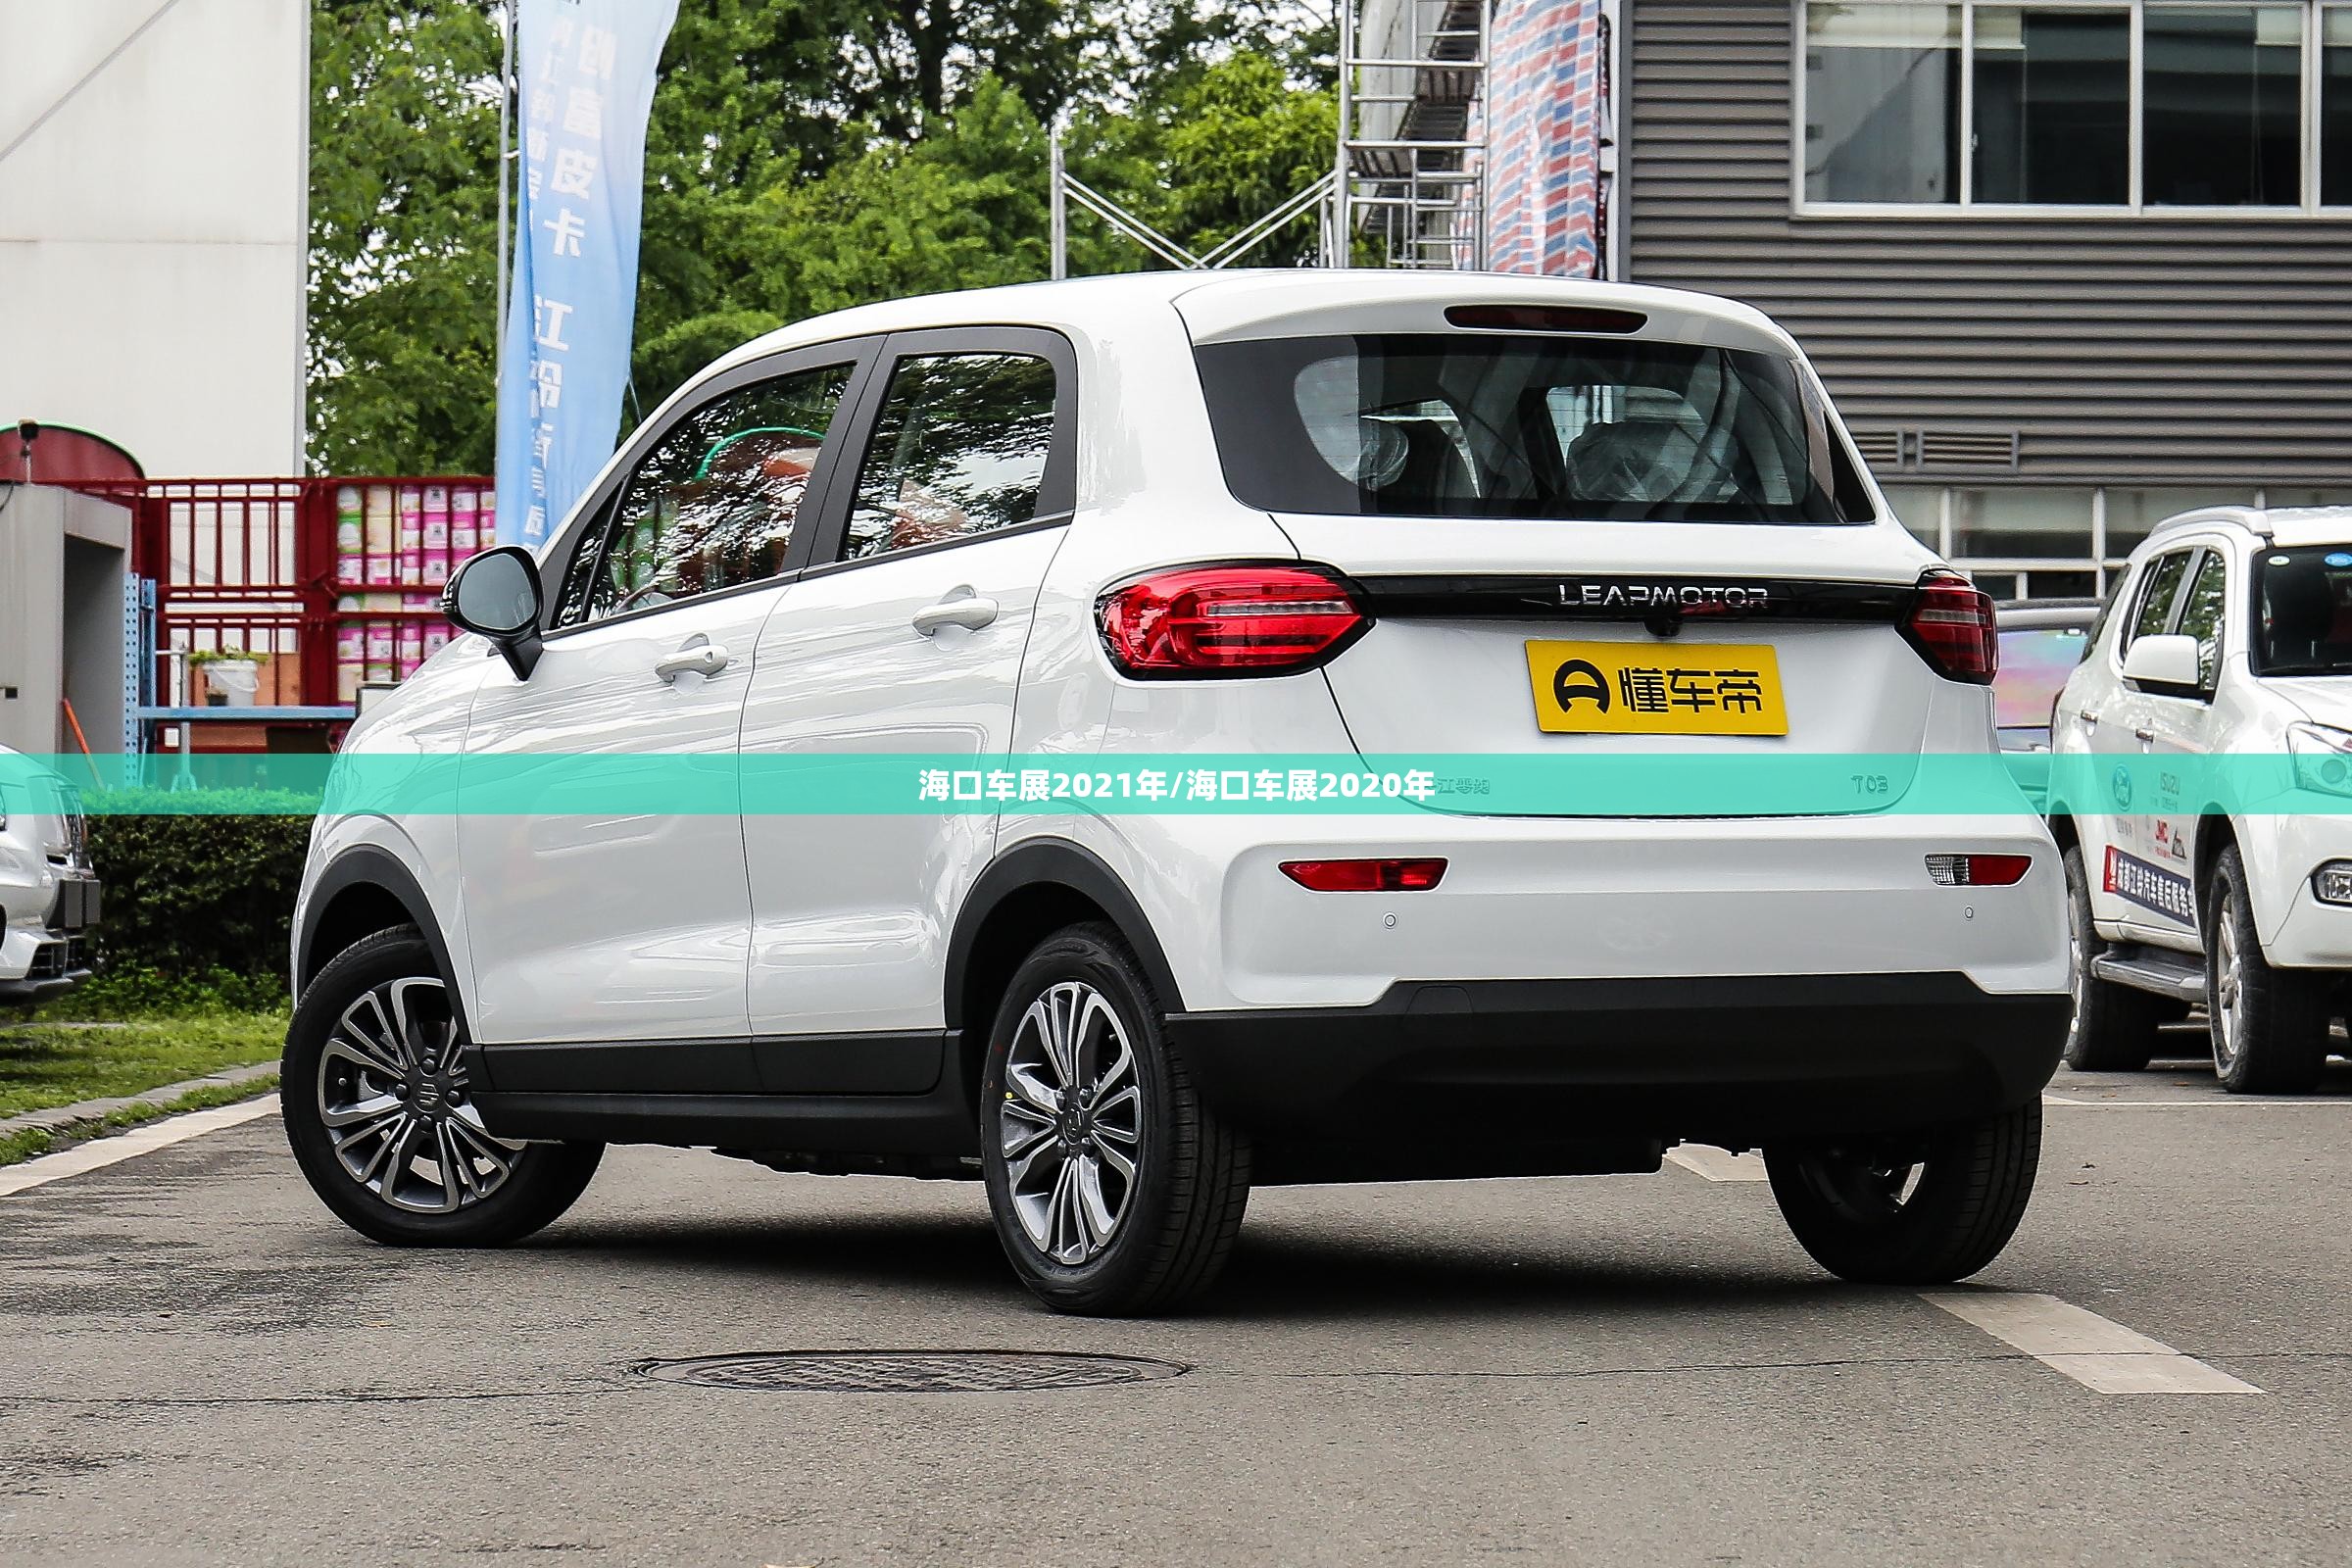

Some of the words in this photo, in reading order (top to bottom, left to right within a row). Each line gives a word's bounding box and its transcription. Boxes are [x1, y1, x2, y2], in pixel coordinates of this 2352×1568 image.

[542, 24, 618, 257] 创富皮卡
[1559, 584, 1768, 608] LEAPMOTOR
[1618, 667, 1763, 714] 懂车帝
[1420, 777, 1491, 796] 江零跑
[1850, 775, 1888, 794] T03
